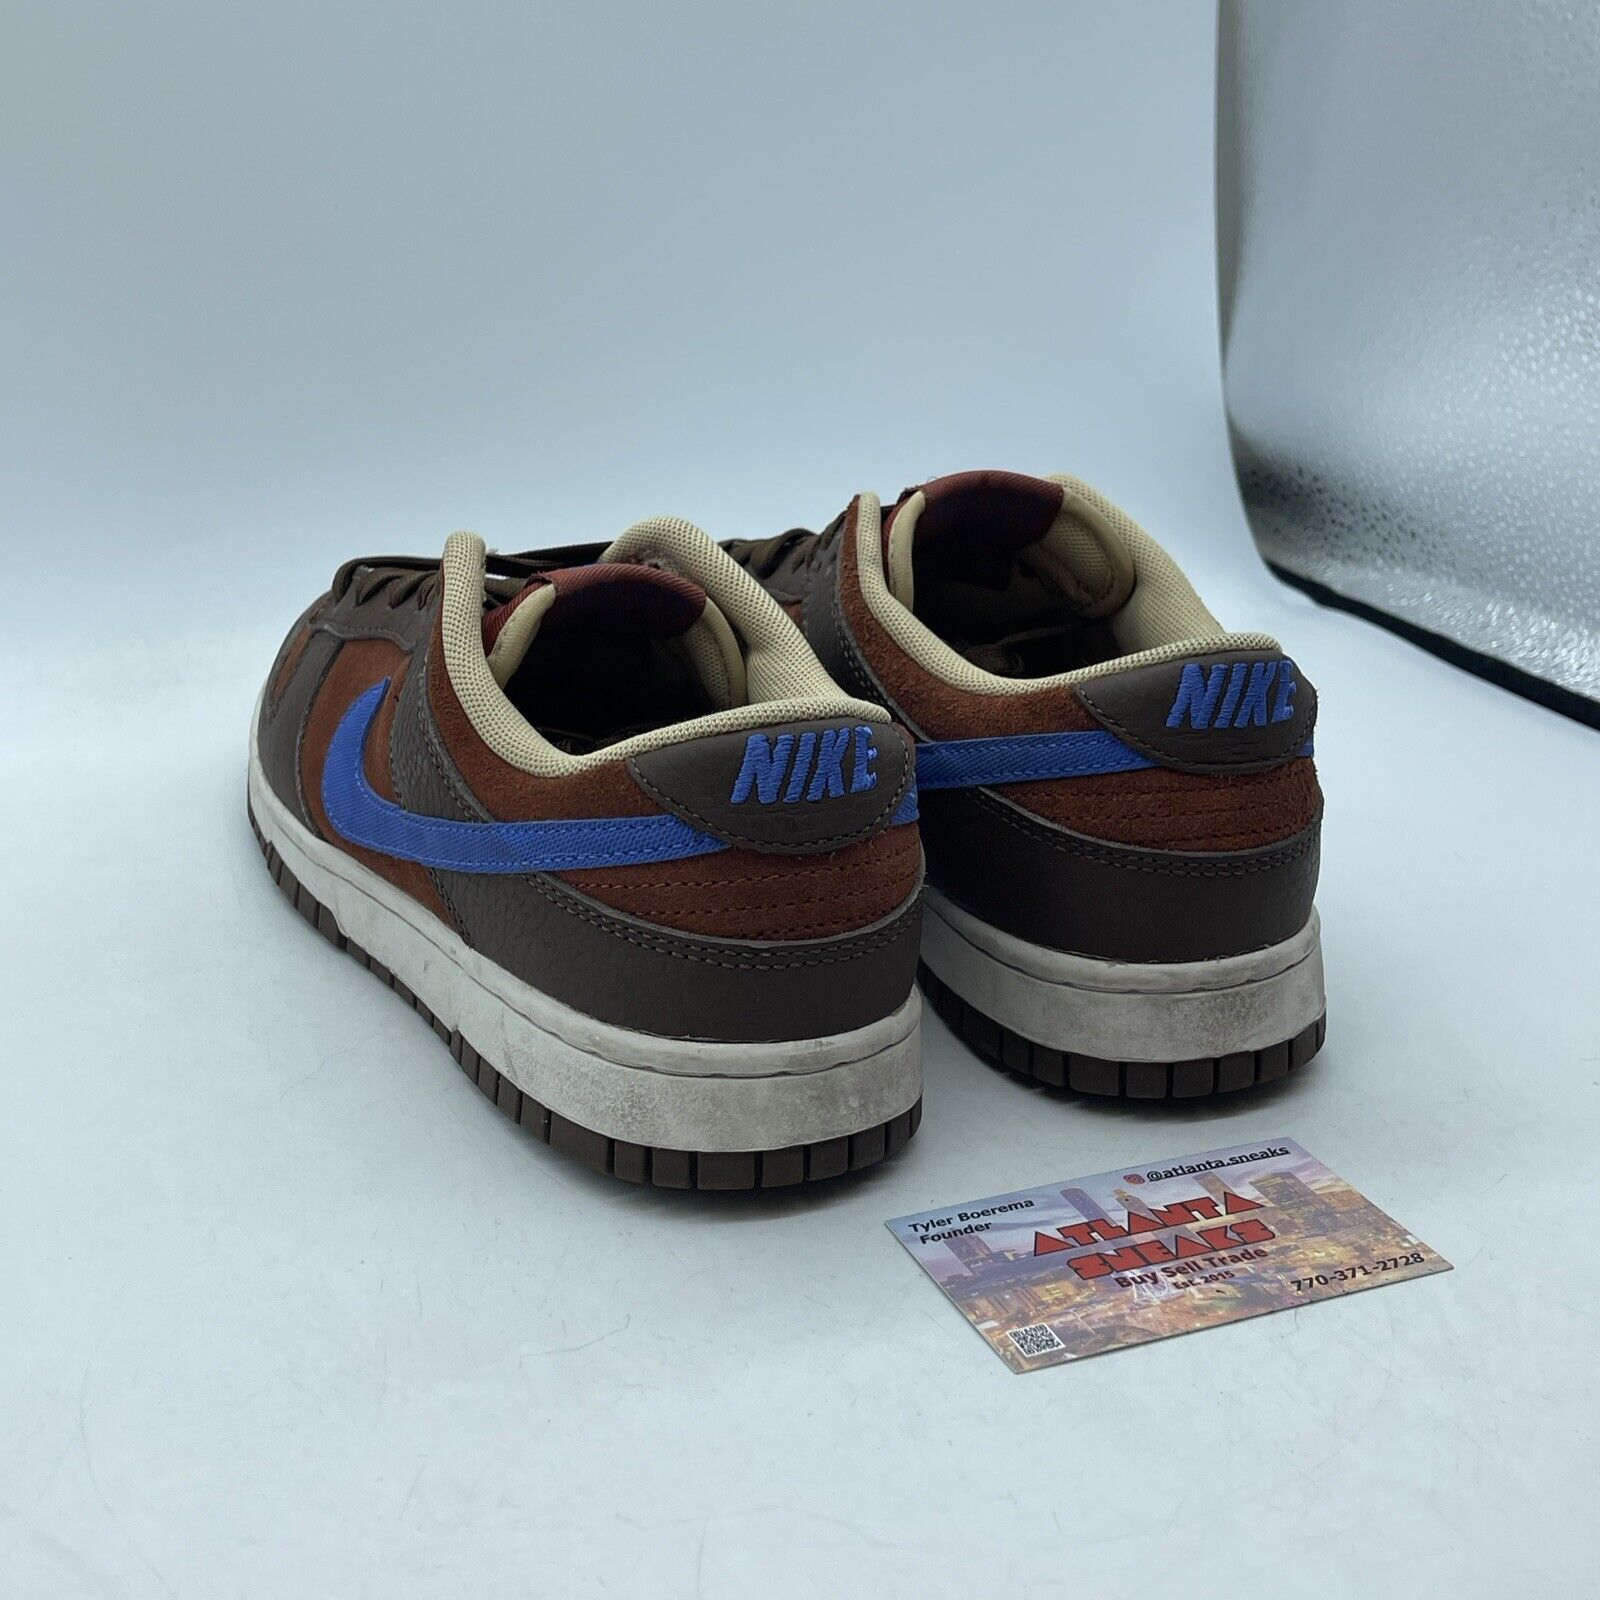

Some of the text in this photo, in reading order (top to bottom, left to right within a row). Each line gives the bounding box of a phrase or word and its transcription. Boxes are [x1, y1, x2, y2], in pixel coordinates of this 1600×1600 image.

[1165, 660, 1298, 730] NIKE
[730, 725, 879, 804] NIKE
[1147, 1146, 1291, 1182] @atlanta.sneaks
[908, 1199, 1035, 1234] Tyler Boerema
[920, 1220, 992, 1245] Founder
[1033, 1191, 1265, 1257] ATLANTA
[1066, 1218, 1276, 1281] SNEAKS
[1114, 1249, 1268, 1289] Buy Sell Trade
[1172, 1270, 1236, 1290] Est. 2015
[1290, 1252, 1426, 1292] 770-371-2728
